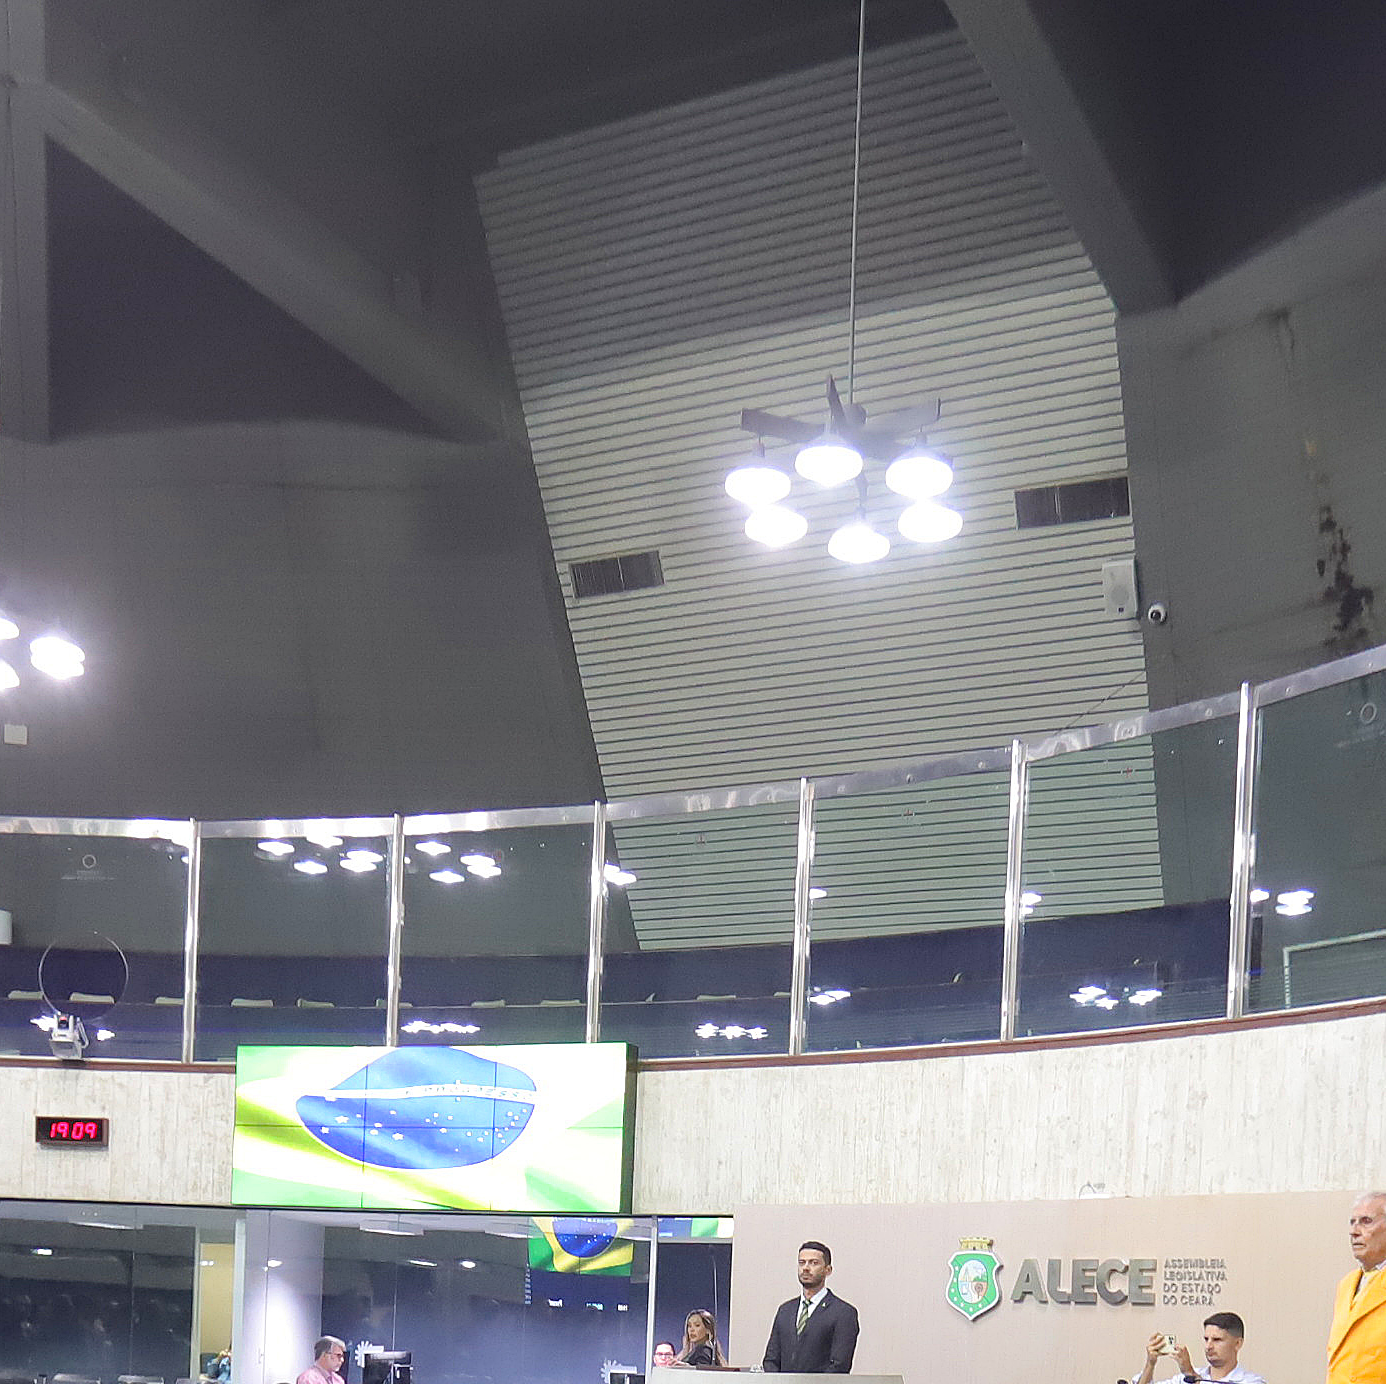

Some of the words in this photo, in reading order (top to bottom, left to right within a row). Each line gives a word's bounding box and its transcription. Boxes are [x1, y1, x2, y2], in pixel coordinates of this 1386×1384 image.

[1164, 1258, 1226, 1269] ASSEMBLEIA
[1164, 1270, 1227, 1281] LEGISLATIVA
[1011, 1258, 1157, 1306] ALECE
[1163, 1283, 1178, 1293] DO
[1181, 1283, 1221, 1294] ESTADO
[1163, 1295, 1177, 1305] DO
